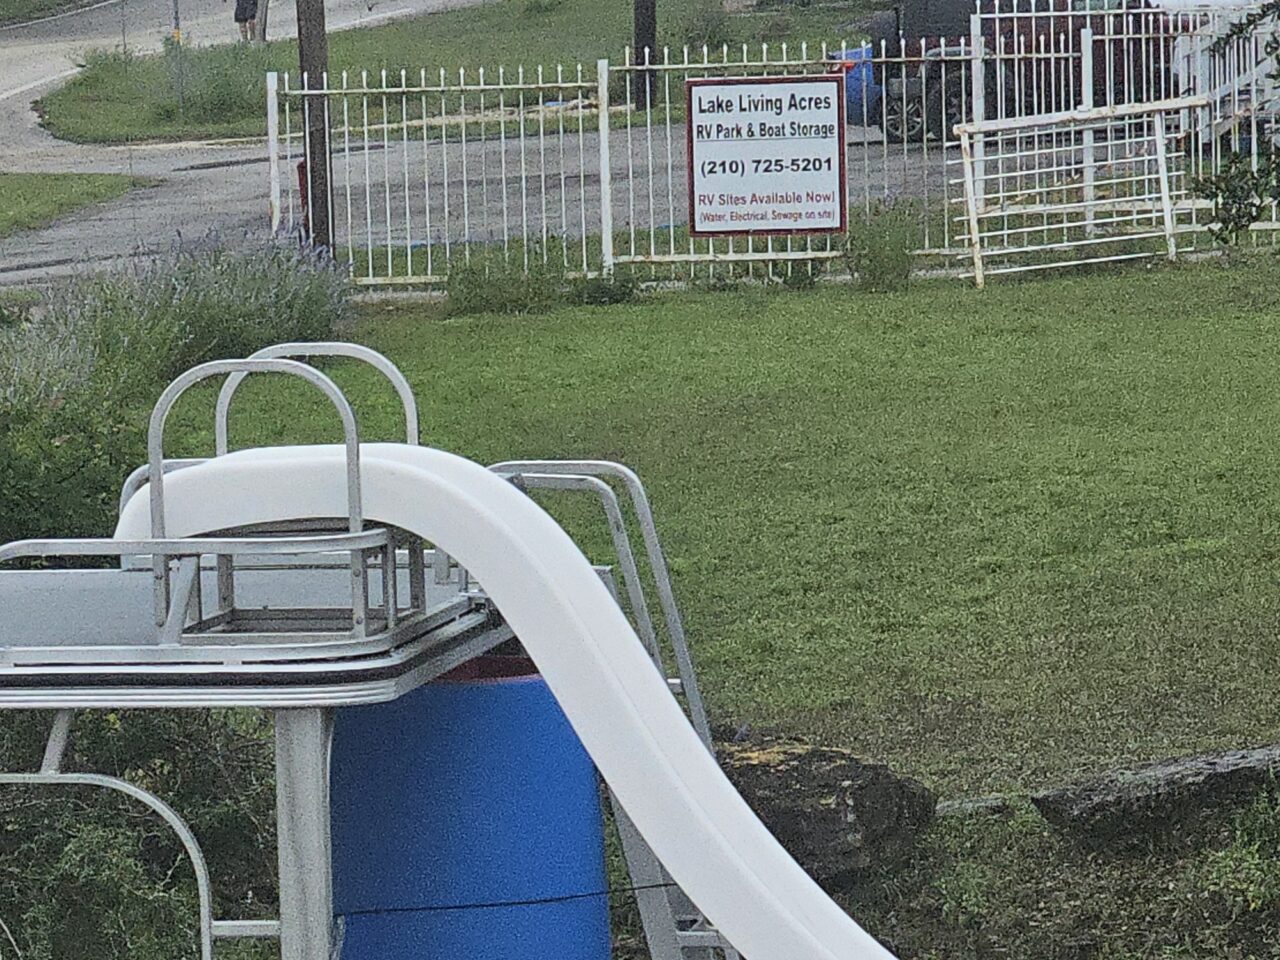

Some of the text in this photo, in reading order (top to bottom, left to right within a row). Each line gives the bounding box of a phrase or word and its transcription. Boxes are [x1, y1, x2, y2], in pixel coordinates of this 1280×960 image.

[698, 93, 831, 116] Lake Living Acres
[696, 121, 835, 139] RV Park & Boat Storage
[700, 157, 832, 178] (210) 725-5201
[698, 190, 835, 206] RV Sites Available Now!
